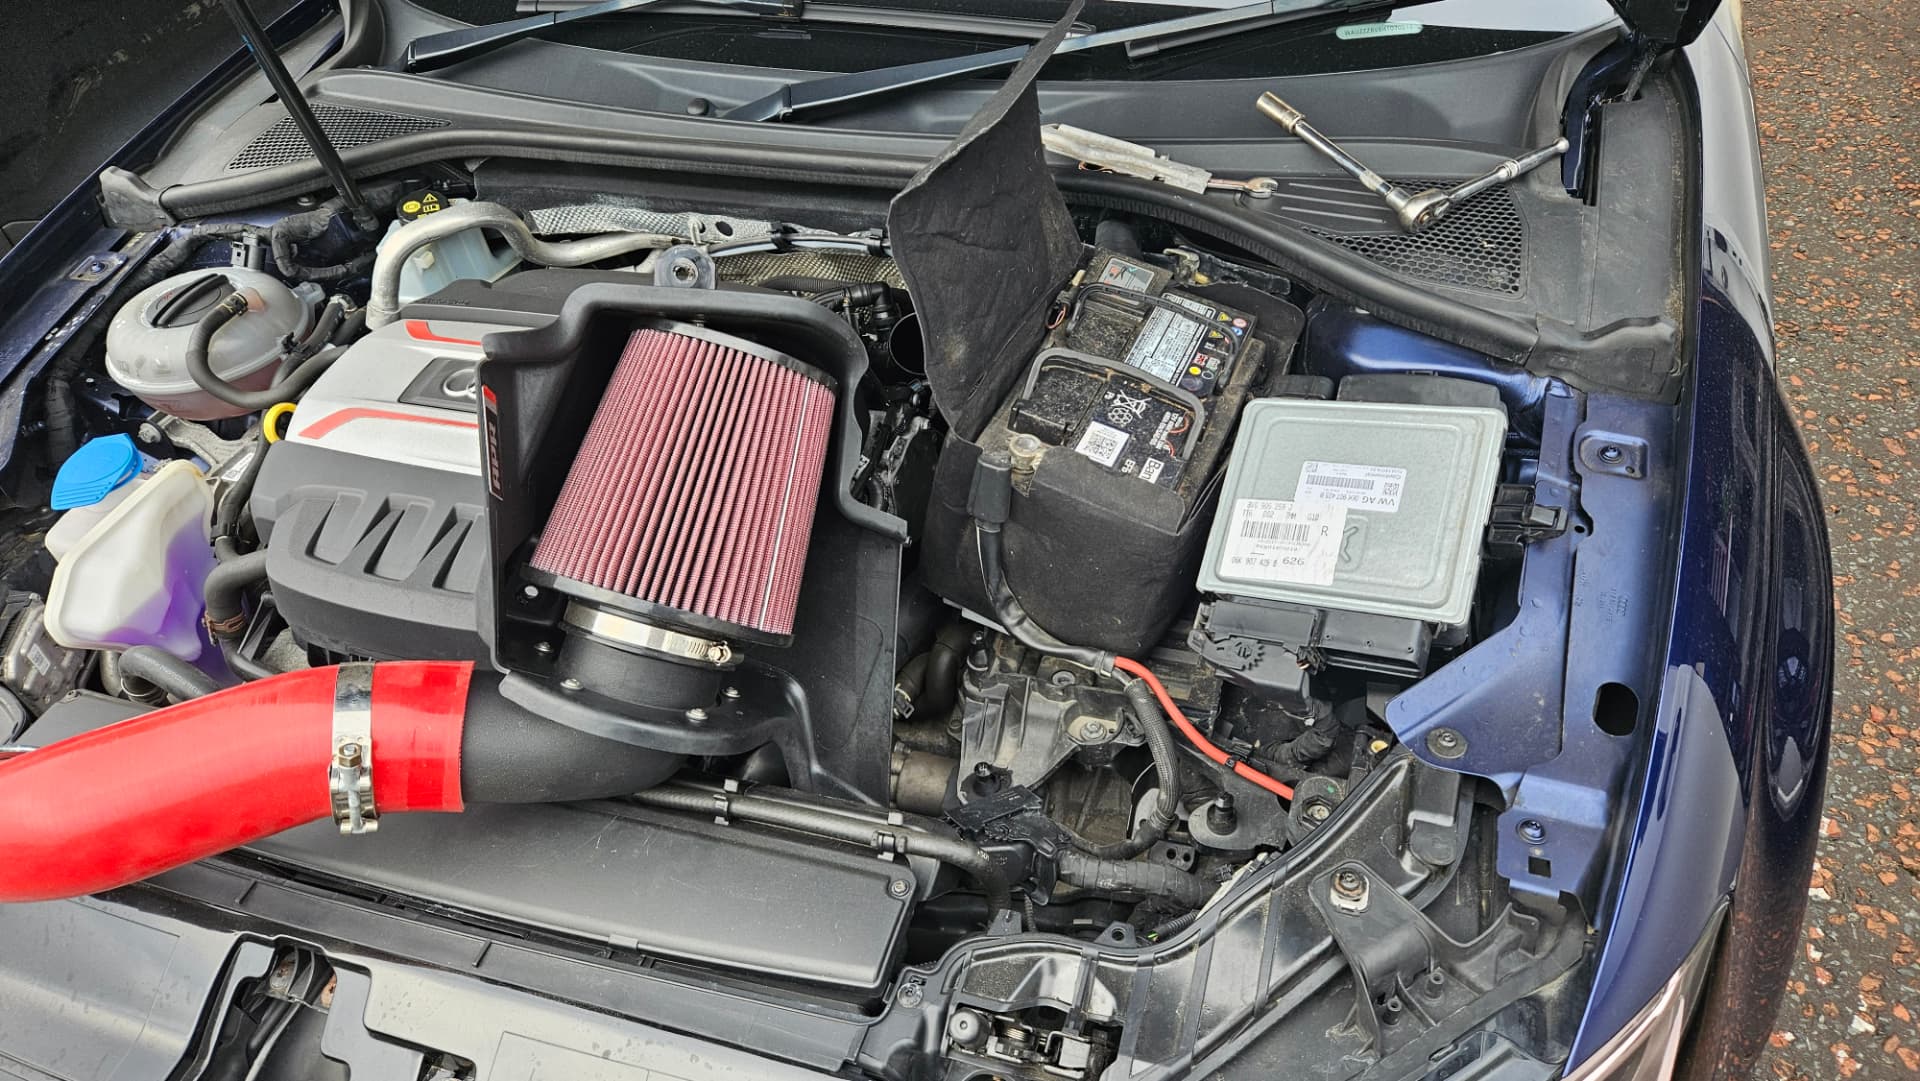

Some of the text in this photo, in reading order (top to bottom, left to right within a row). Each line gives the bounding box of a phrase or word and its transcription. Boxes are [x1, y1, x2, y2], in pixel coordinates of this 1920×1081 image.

[488, 422, 501, 490] APR
[1142, 460, 1162, 480] Ban
[1361, 496, 1376, 504] AG
[1377, 497, 1396, 506] VW
[1320, 525, 1329, 537] R
